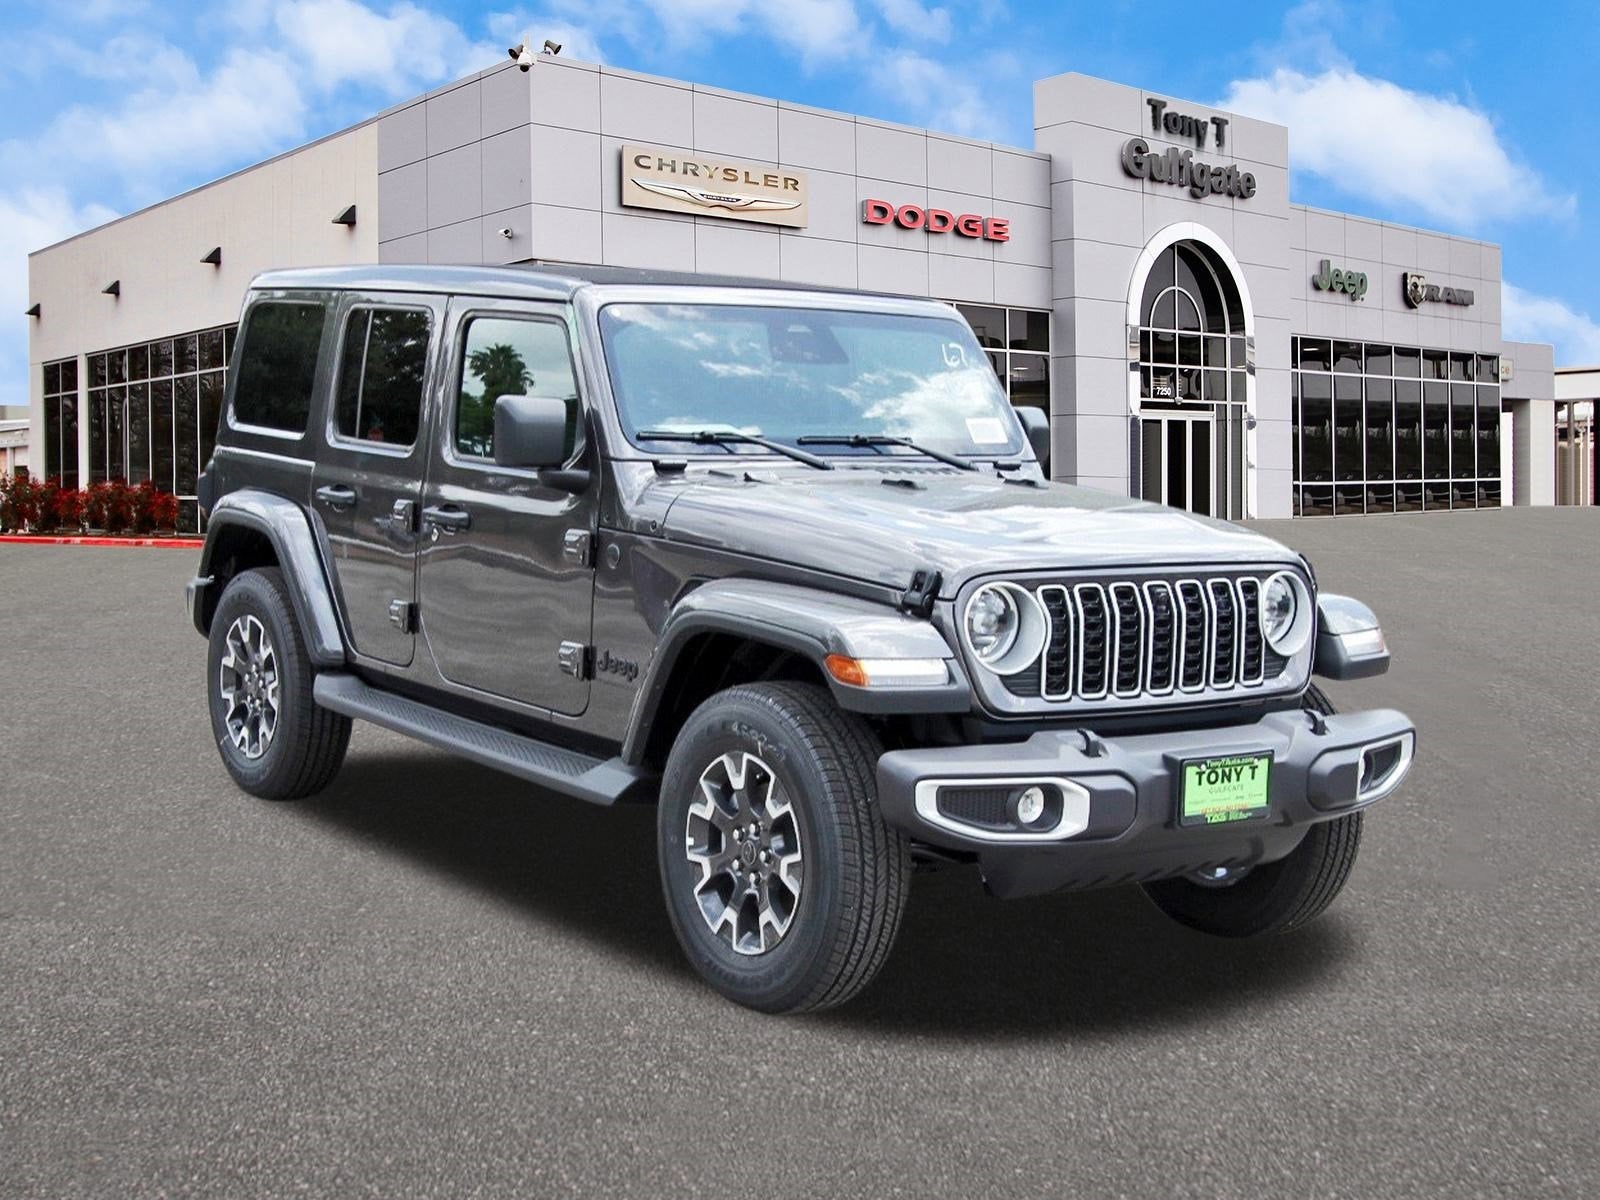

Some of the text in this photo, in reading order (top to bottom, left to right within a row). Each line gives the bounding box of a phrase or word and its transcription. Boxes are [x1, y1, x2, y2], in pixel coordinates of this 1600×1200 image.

[1146, 98, 1229, 148] Tony T
[633, 153, 800, 193] CHRYSLER
[1120, 137, 1256, 199] Gulfgate
[862, 198, 1010, 243] DODGE
[1312, 259, 1368, 301] Jeep
[1425, 283, 1475, 307] RAM
[597, 649, 640, 683] Jeep
[1195, 765, 1259, 786] TONY T
